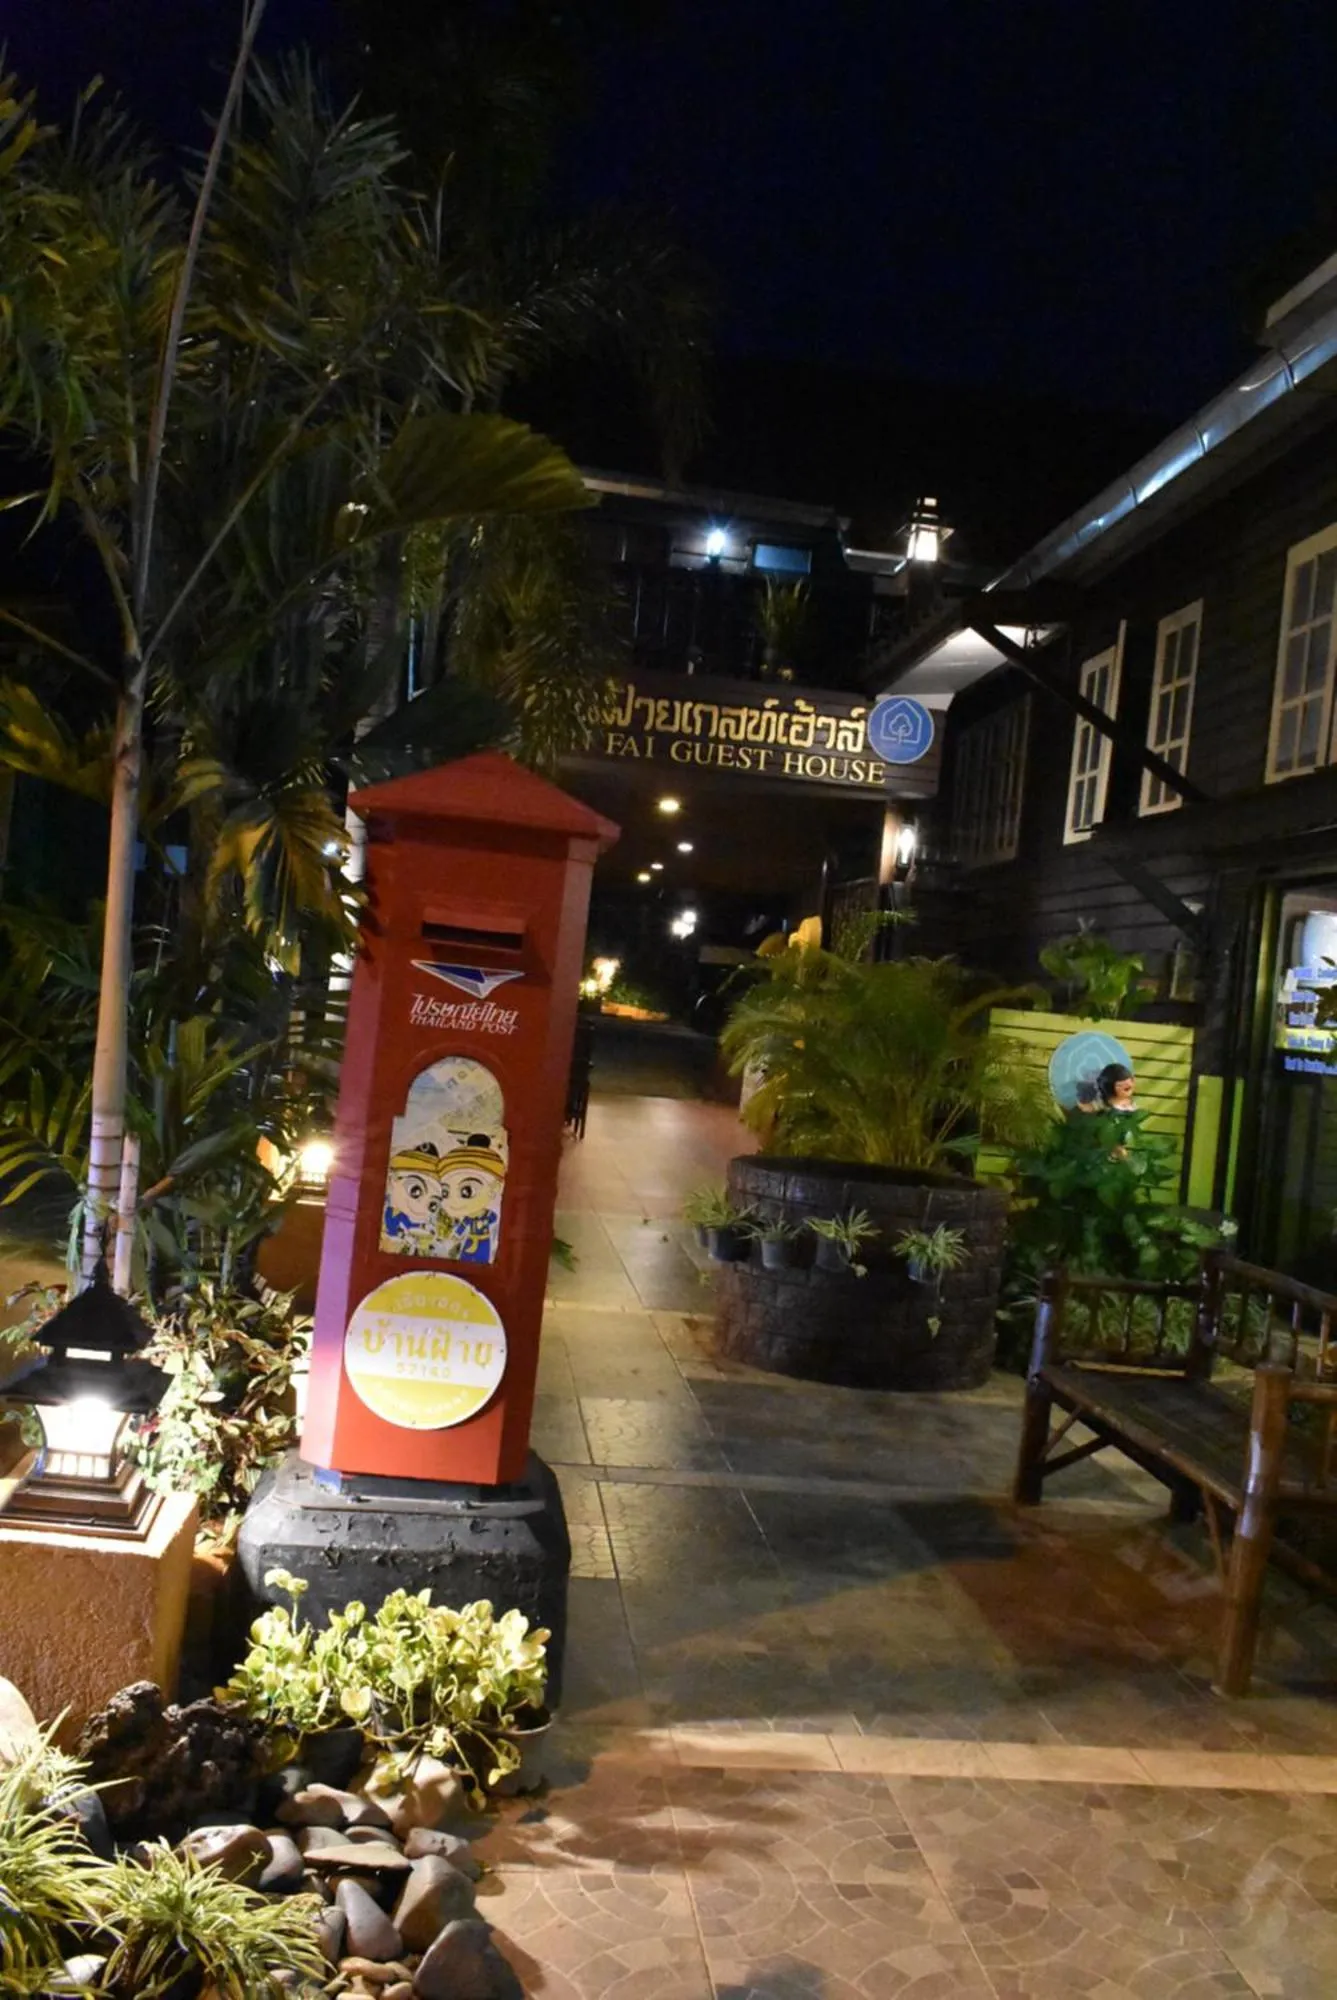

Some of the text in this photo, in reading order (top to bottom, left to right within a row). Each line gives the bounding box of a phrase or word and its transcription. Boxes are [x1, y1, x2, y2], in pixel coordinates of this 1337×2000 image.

[606, 731, 655, 759] FAI
[670, 739, 773, 771] GUEST
[783, 751, 886, 785] HOUSE
[409, 1014, 518, 1035] THAILAND POST
